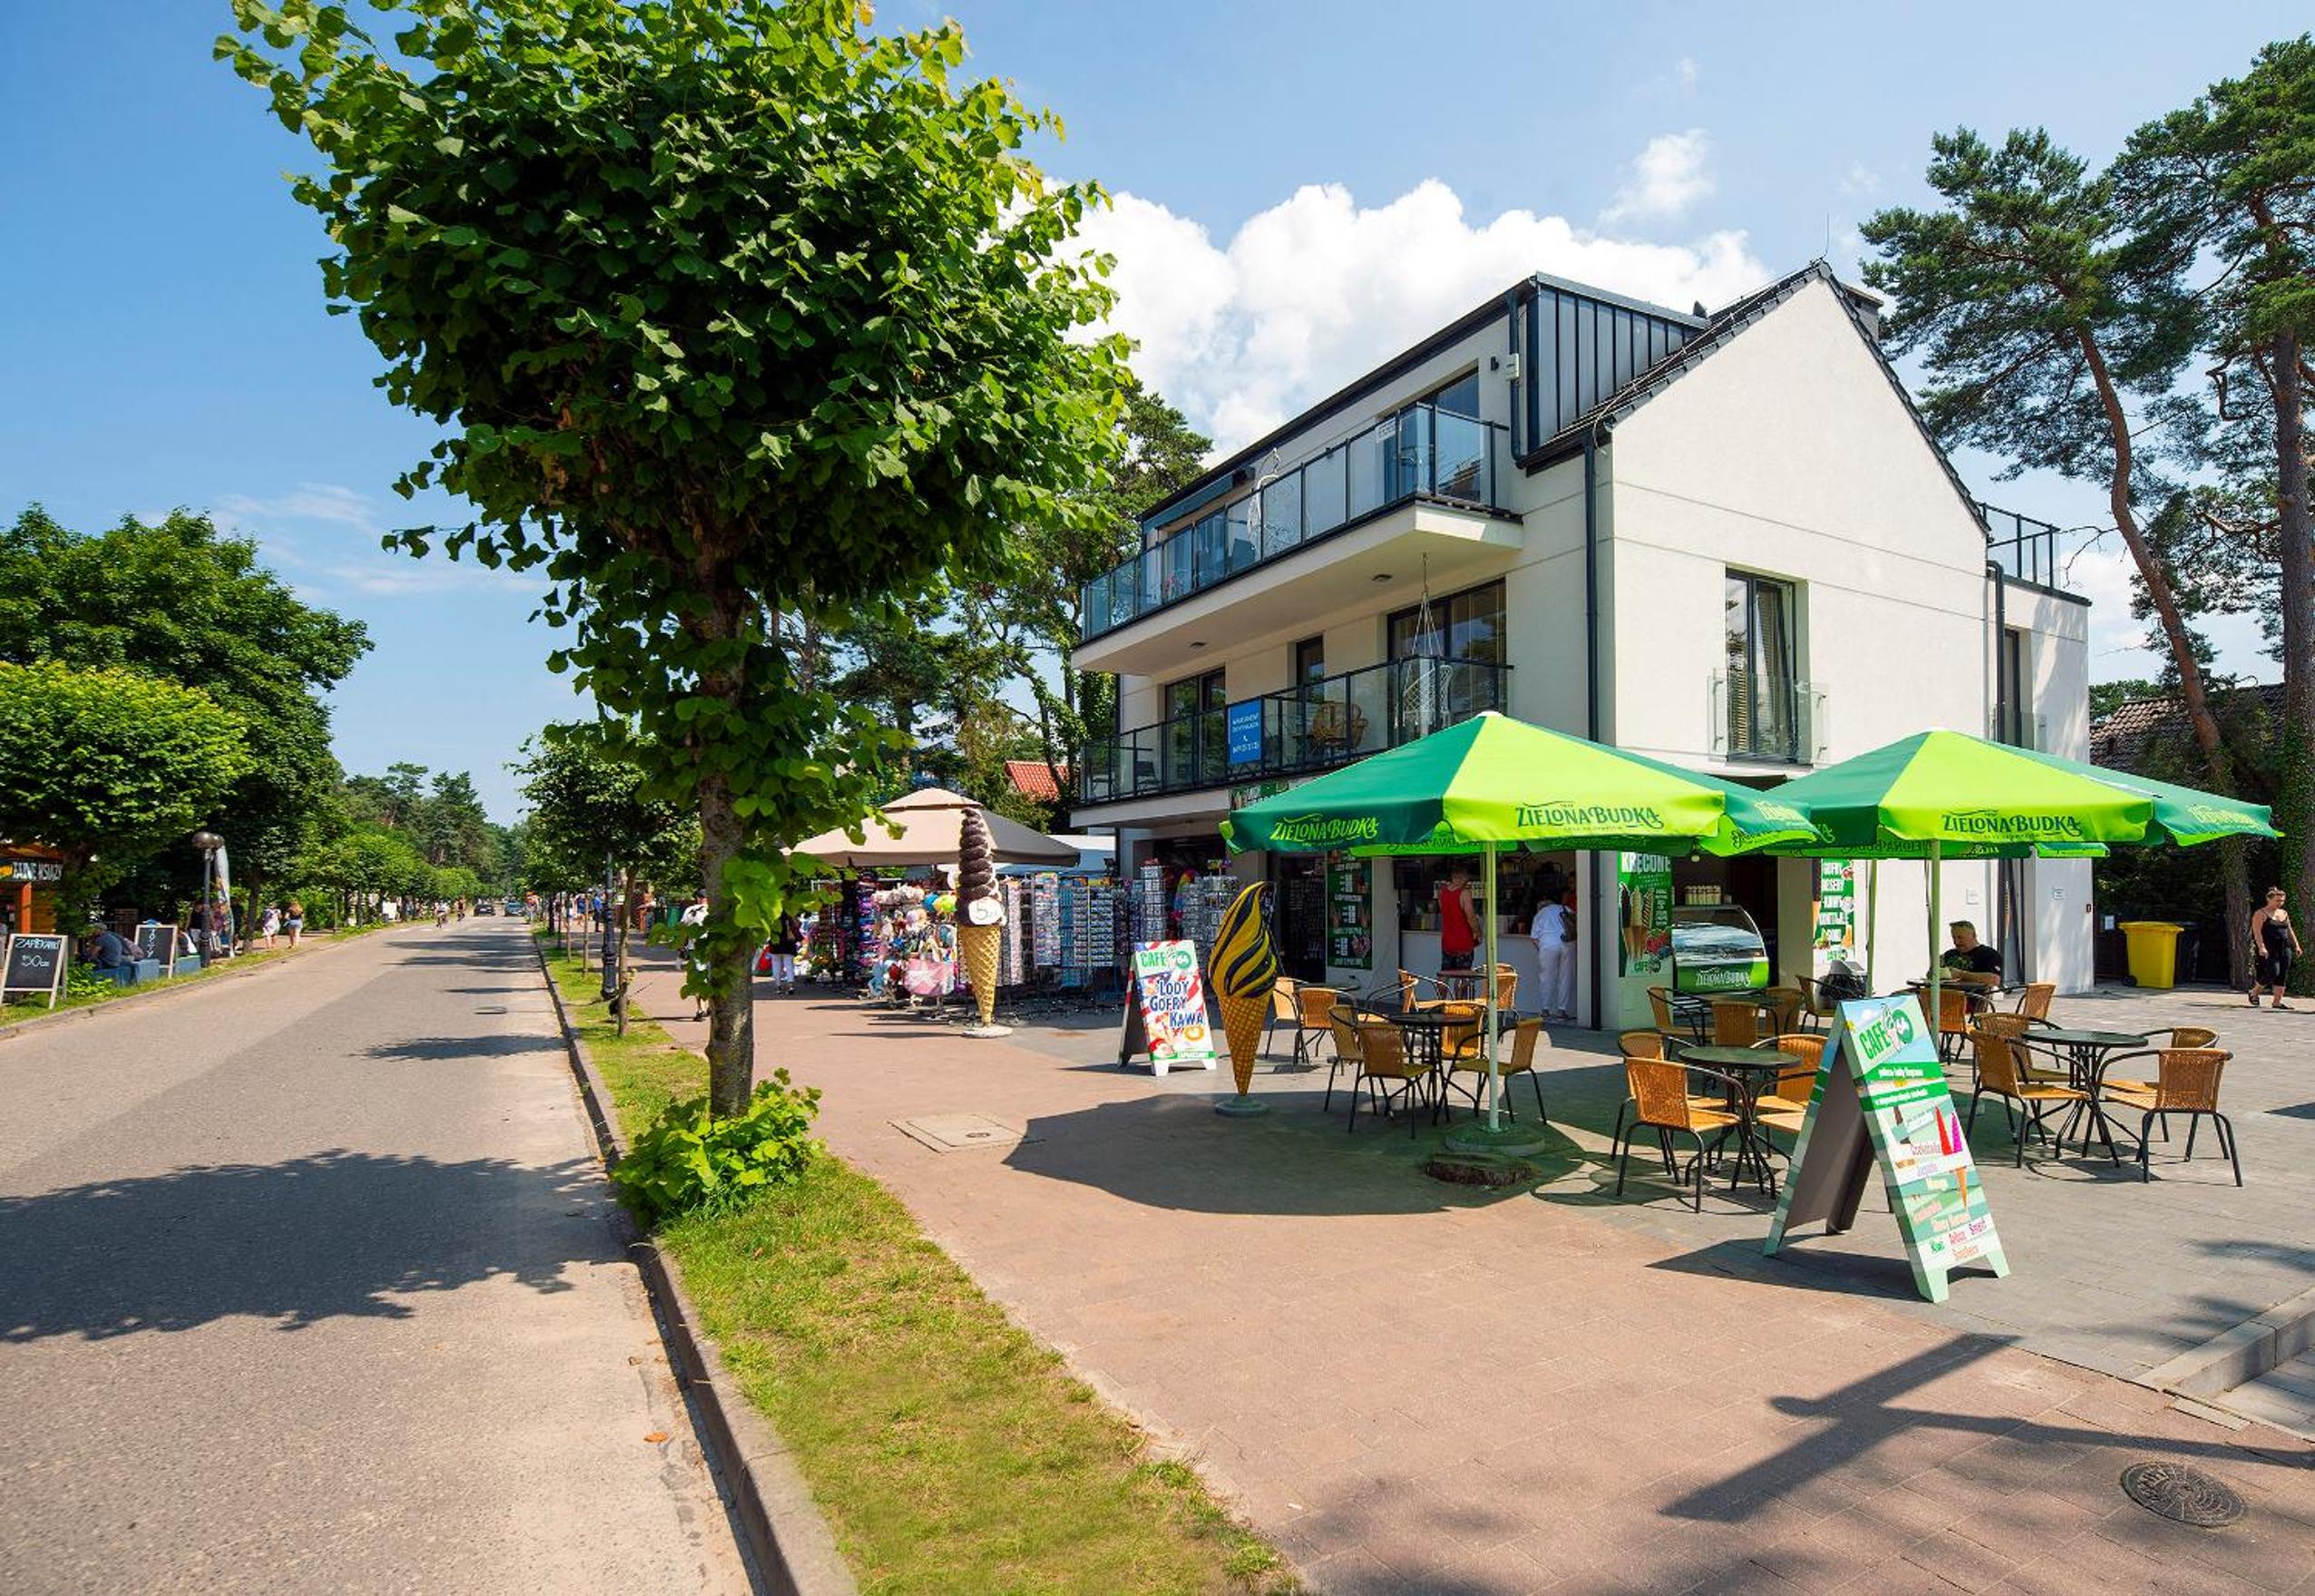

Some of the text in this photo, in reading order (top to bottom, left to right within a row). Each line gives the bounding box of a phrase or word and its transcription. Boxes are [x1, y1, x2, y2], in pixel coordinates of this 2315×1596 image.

[1515, 805, 1665, 830] ZIELONA BUDKA
[1942, 814, 2083, 837] ZIELONA BUDKA
[1269, 817, 1379, 842] ZIELONA BUDKA
[1141, 952, 1166, 968] CAFE
[1159, 980, 1189, 996] LODY
[1149, 996, 1187, 1012] GOFRY
[1170, 1011, 1204, 1027] KAWA
[1859, 1021, 1892, 1060] CAFE
